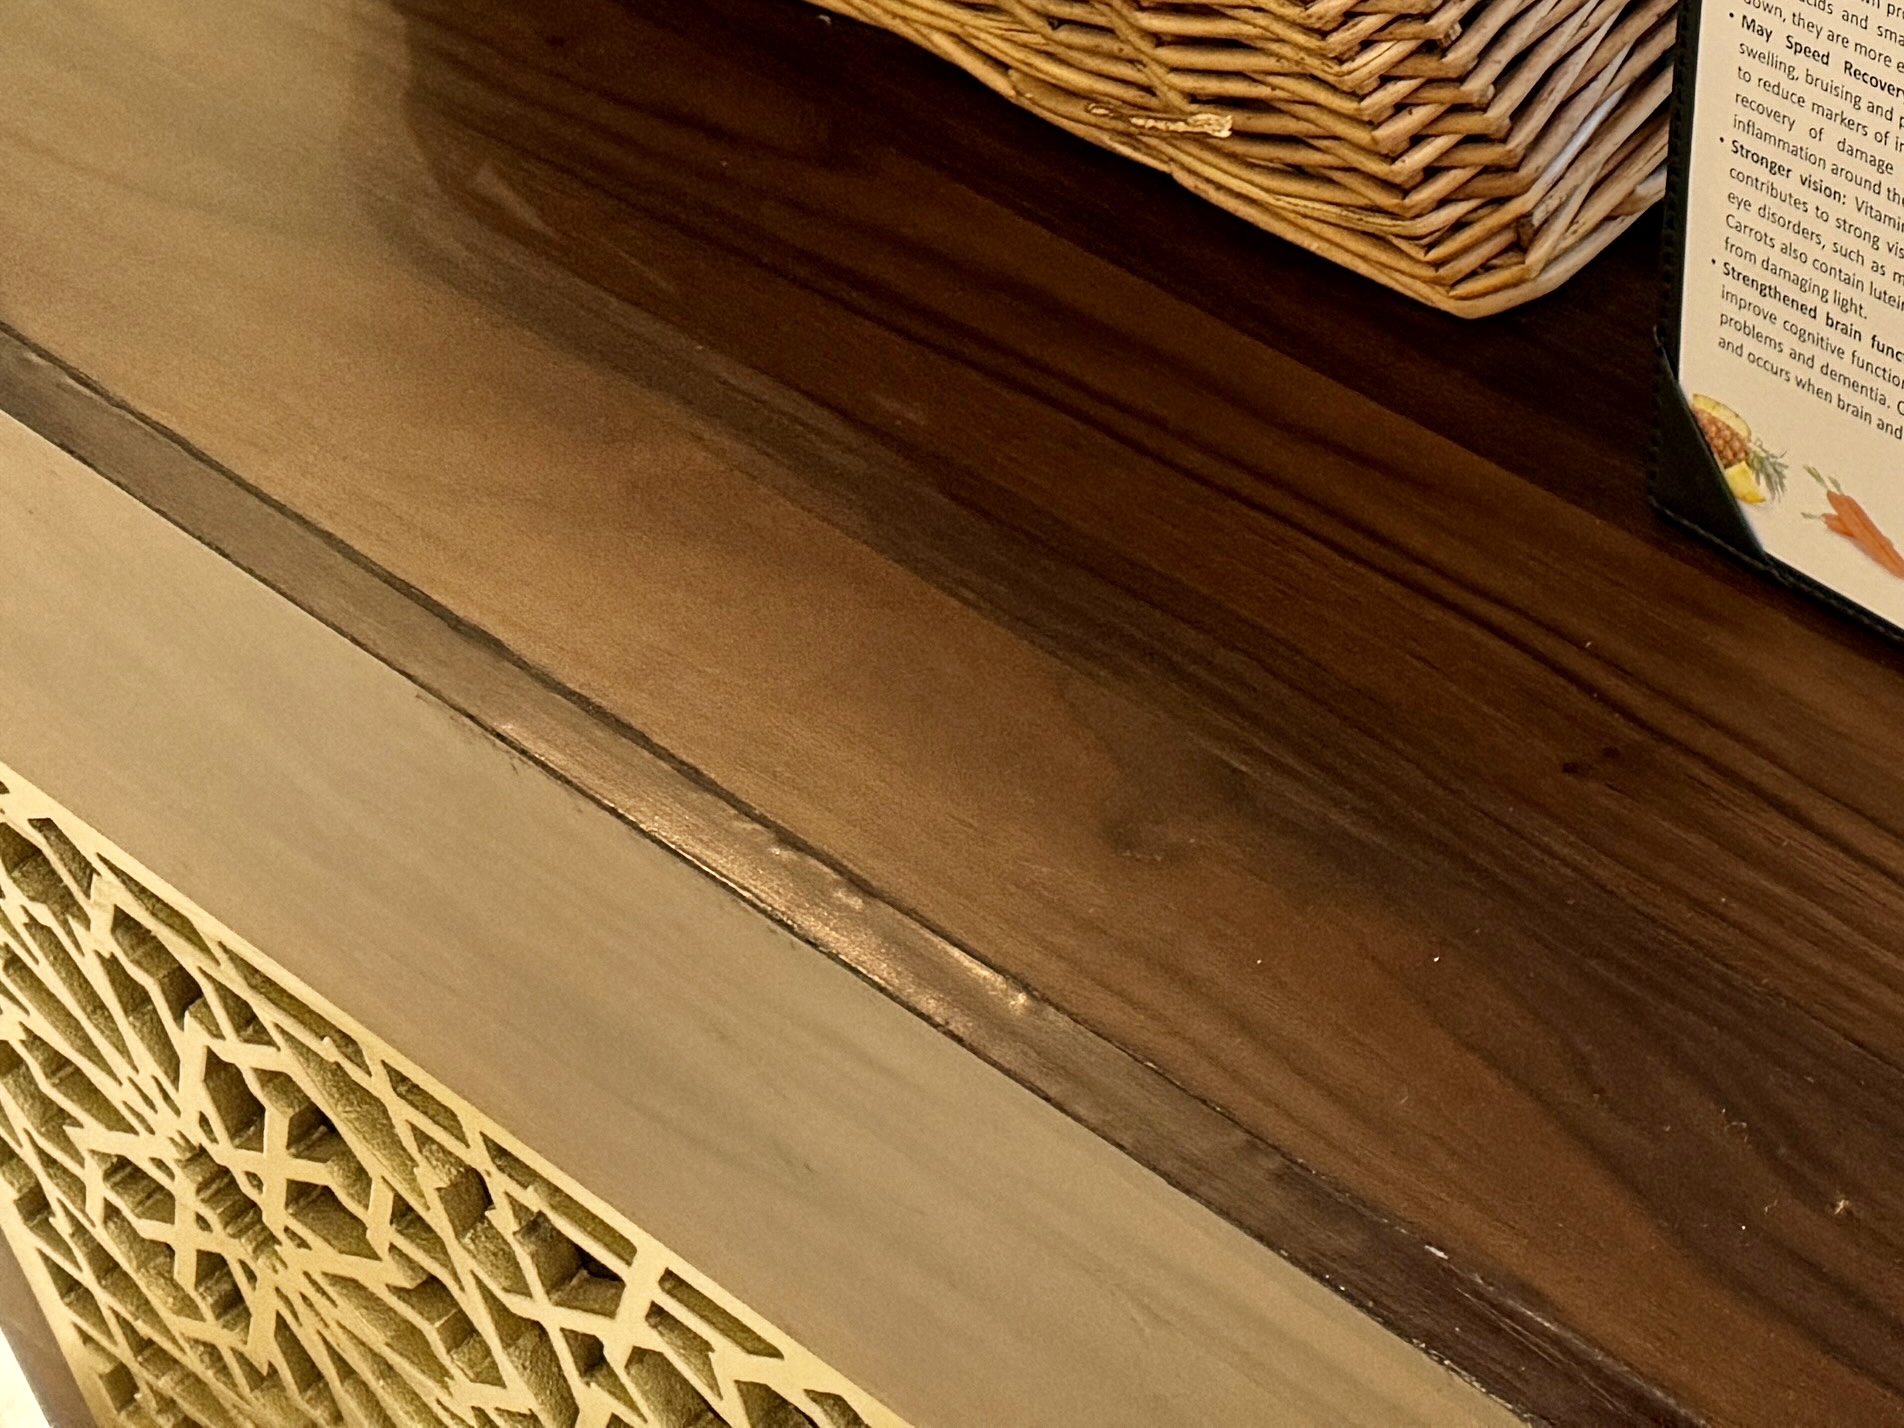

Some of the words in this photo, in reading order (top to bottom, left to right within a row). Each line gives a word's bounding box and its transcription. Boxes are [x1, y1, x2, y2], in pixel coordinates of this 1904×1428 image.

[1740, 12, 1773, 44] May
[1784, 33, 1831, 67] Speed
[1790, 10, 1824, 41] they
[1825, 27, 1850, 49] are
[1852, 40, 1893, 69] more
[1840, 8, 1869, 31] and
[1736, 64, 1752, 84] to
[1756, 76, 1807, 109] reduce
[1809, 100, 1869, 137] markers
[1872, 129, 1892, 147] of
[1738, 41, 1800, 82] swelling,
[1803, 66, 1863, 112] bruising
[1864, 99, 1895, 123] and
[1729, 138, 1793, 179] Stronger
[1798, 172, 1847, 206] vision:
[1732, 112, 1827, 171] inflammation
[1829, 161, 1883, 196] around
[1734, 91, 1797, 133] recovery
[1807, 125, 1825, 143] of
[1835, 136, 1894, 176] damage
[1726, 190, 1753, 213] eye
[1756, 202, 1826, 252] disorders,
[1830, 240, 1865, 267] such
[1869, 258, 1886, 277] as
[1721, 260, 1818, 321] Strengthened
[1824, 309, 1862, 343] brain
[1718, 311, 1784, 354] problems
[1787, 346, 1815, 370] and
[1818, 360, 1891, 410] dementia.
